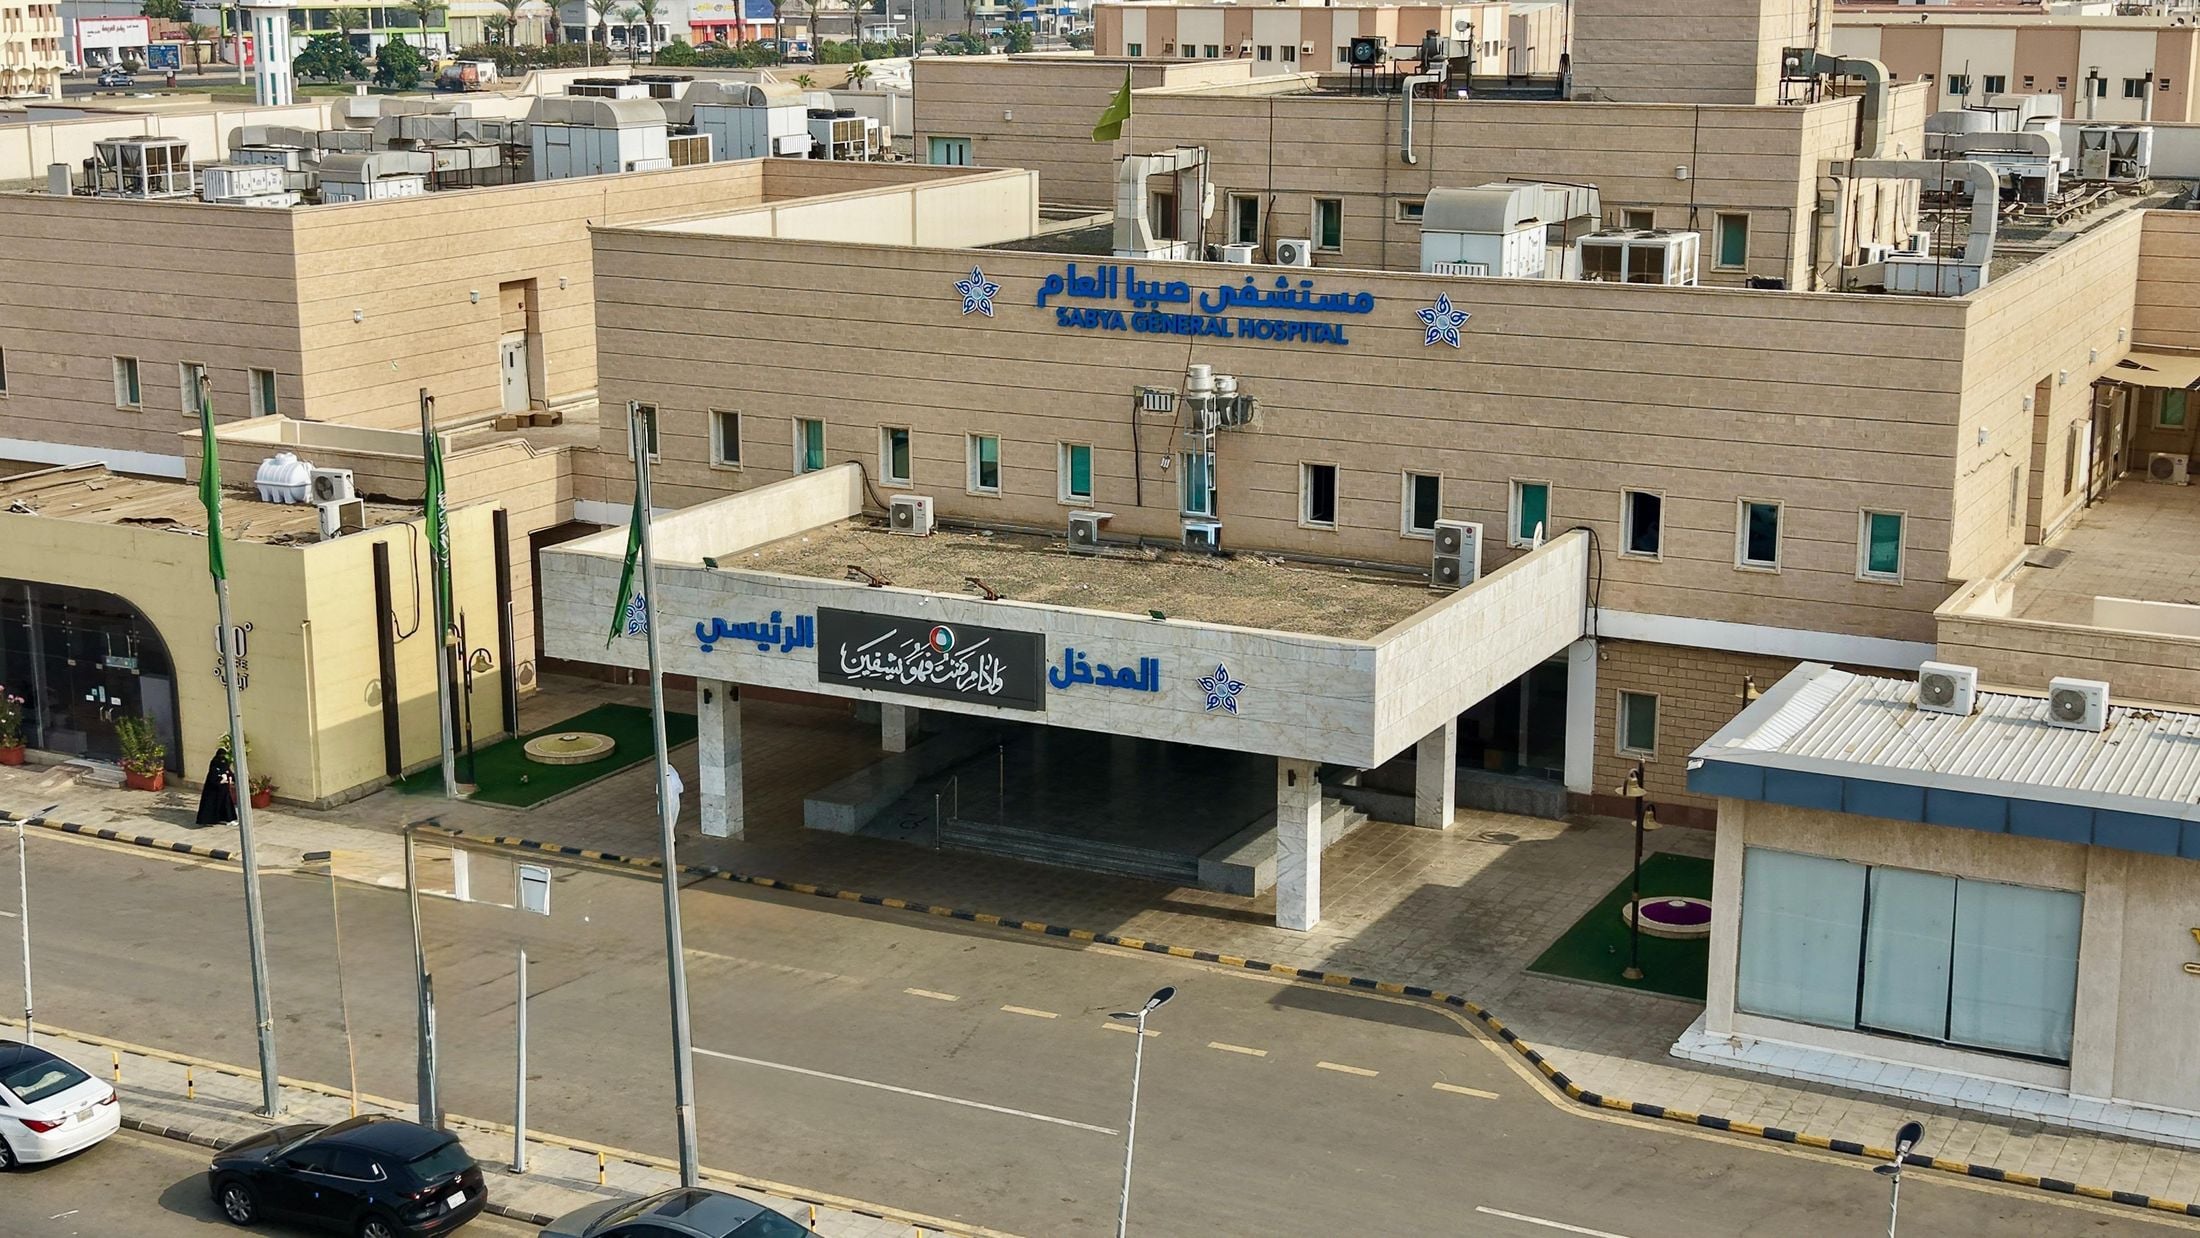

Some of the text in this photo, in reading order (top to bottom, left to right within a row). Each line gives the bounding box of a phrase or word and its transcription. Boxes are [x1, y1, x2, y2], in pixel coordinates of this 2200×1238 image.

[1037, 263, 1375, 314] مستشفى صبيا العام
[1056, 306, 1349, 346] SABYA GENERAL HOSPITAL
[695, 610, 1159, 692] المدخل الرئيسي
